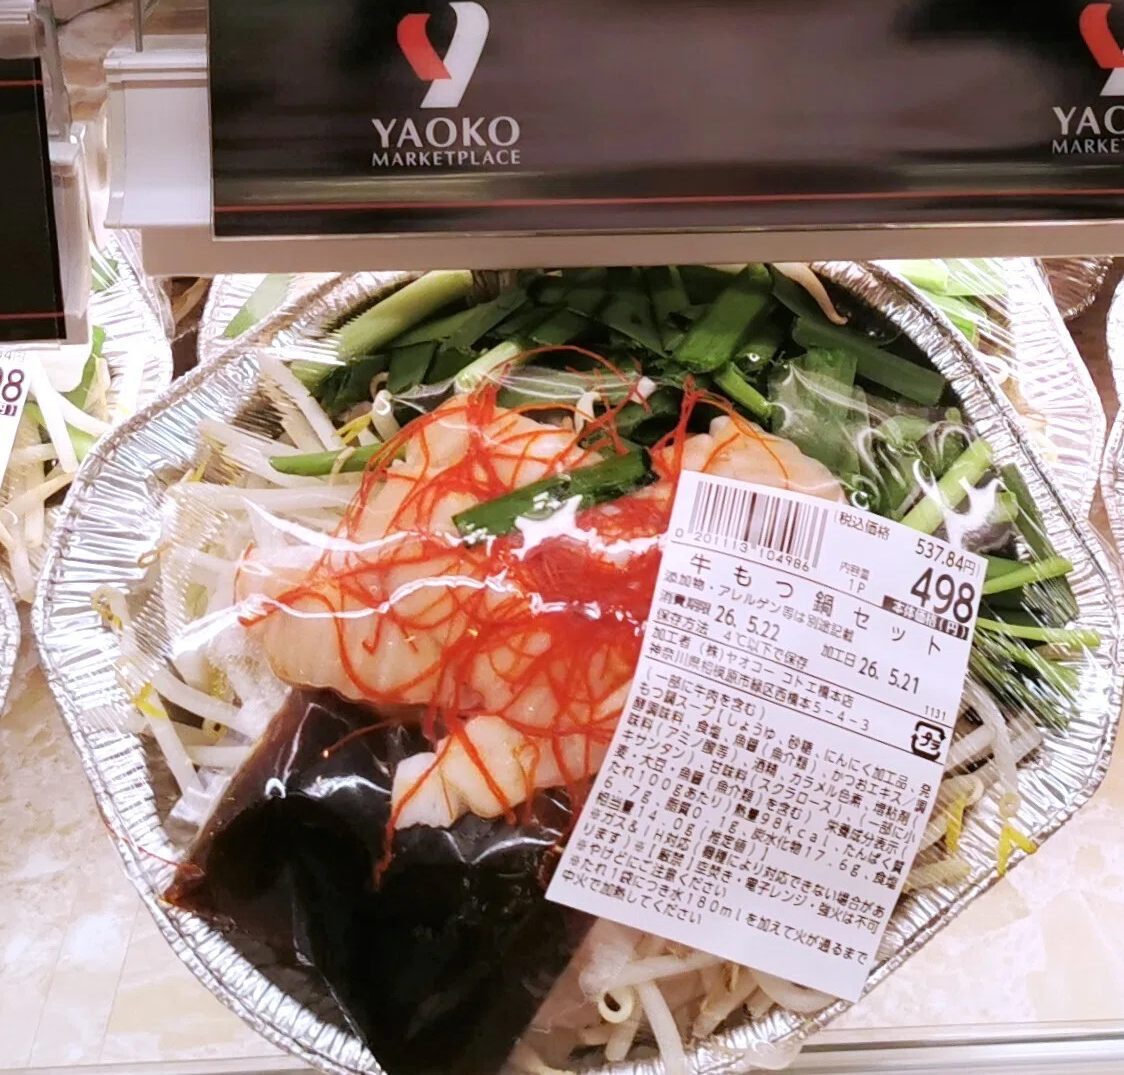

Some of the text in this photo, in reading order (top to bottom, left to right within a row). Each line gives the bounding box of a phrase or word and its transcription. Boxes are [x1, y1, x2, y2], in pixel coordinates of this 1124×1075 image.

[372, 116, 520, 148] YAOKO
[372, 149, 520, 166] MARKETPLACE
[0, 367, 25, 403] 8
[906, 564, 981, 624] 498
